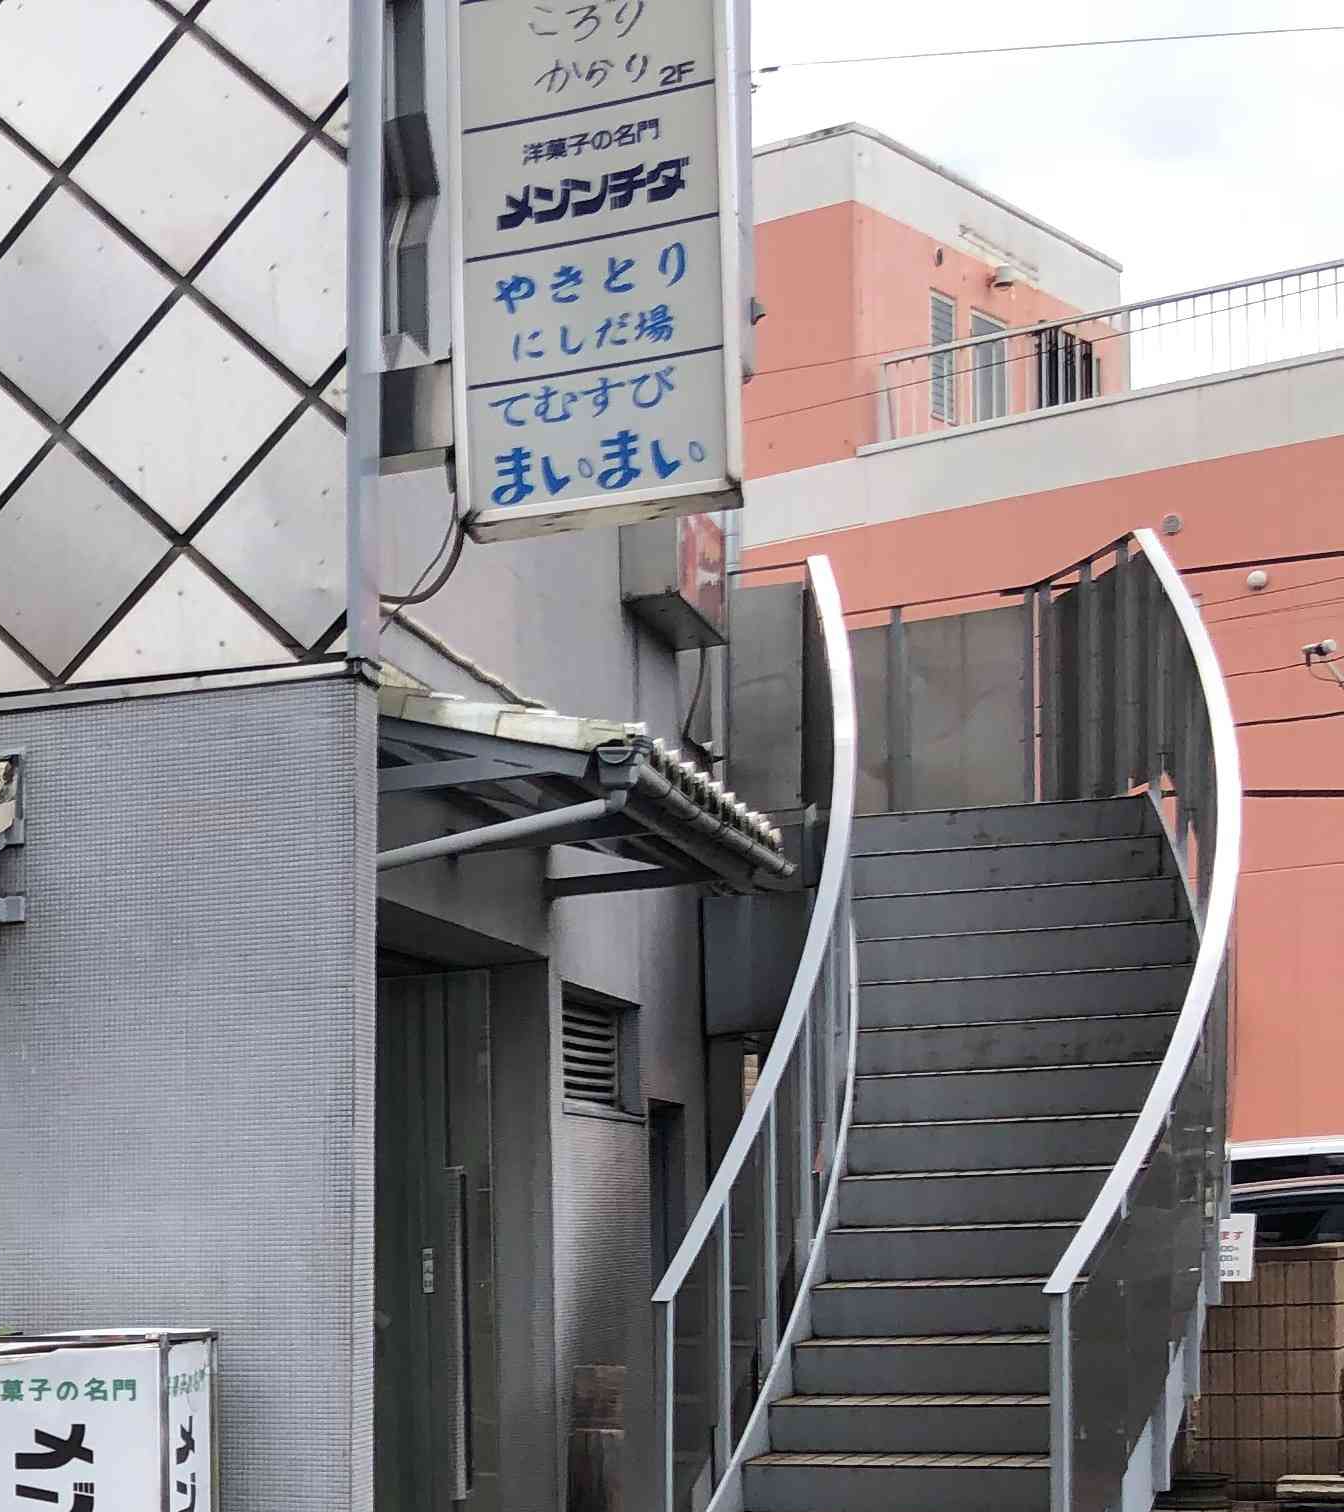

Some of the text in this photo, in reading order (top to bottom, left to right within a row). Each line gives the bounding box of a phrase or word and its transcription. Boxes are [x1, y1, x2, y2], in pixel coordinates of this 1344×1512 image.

[659, 60, 696, 86] 2F
[522, 118, 660, 165] 洋菓子の名門
[493, 241, 688, 314] やきとり
[512, 303, 675, 361] にしだ場
